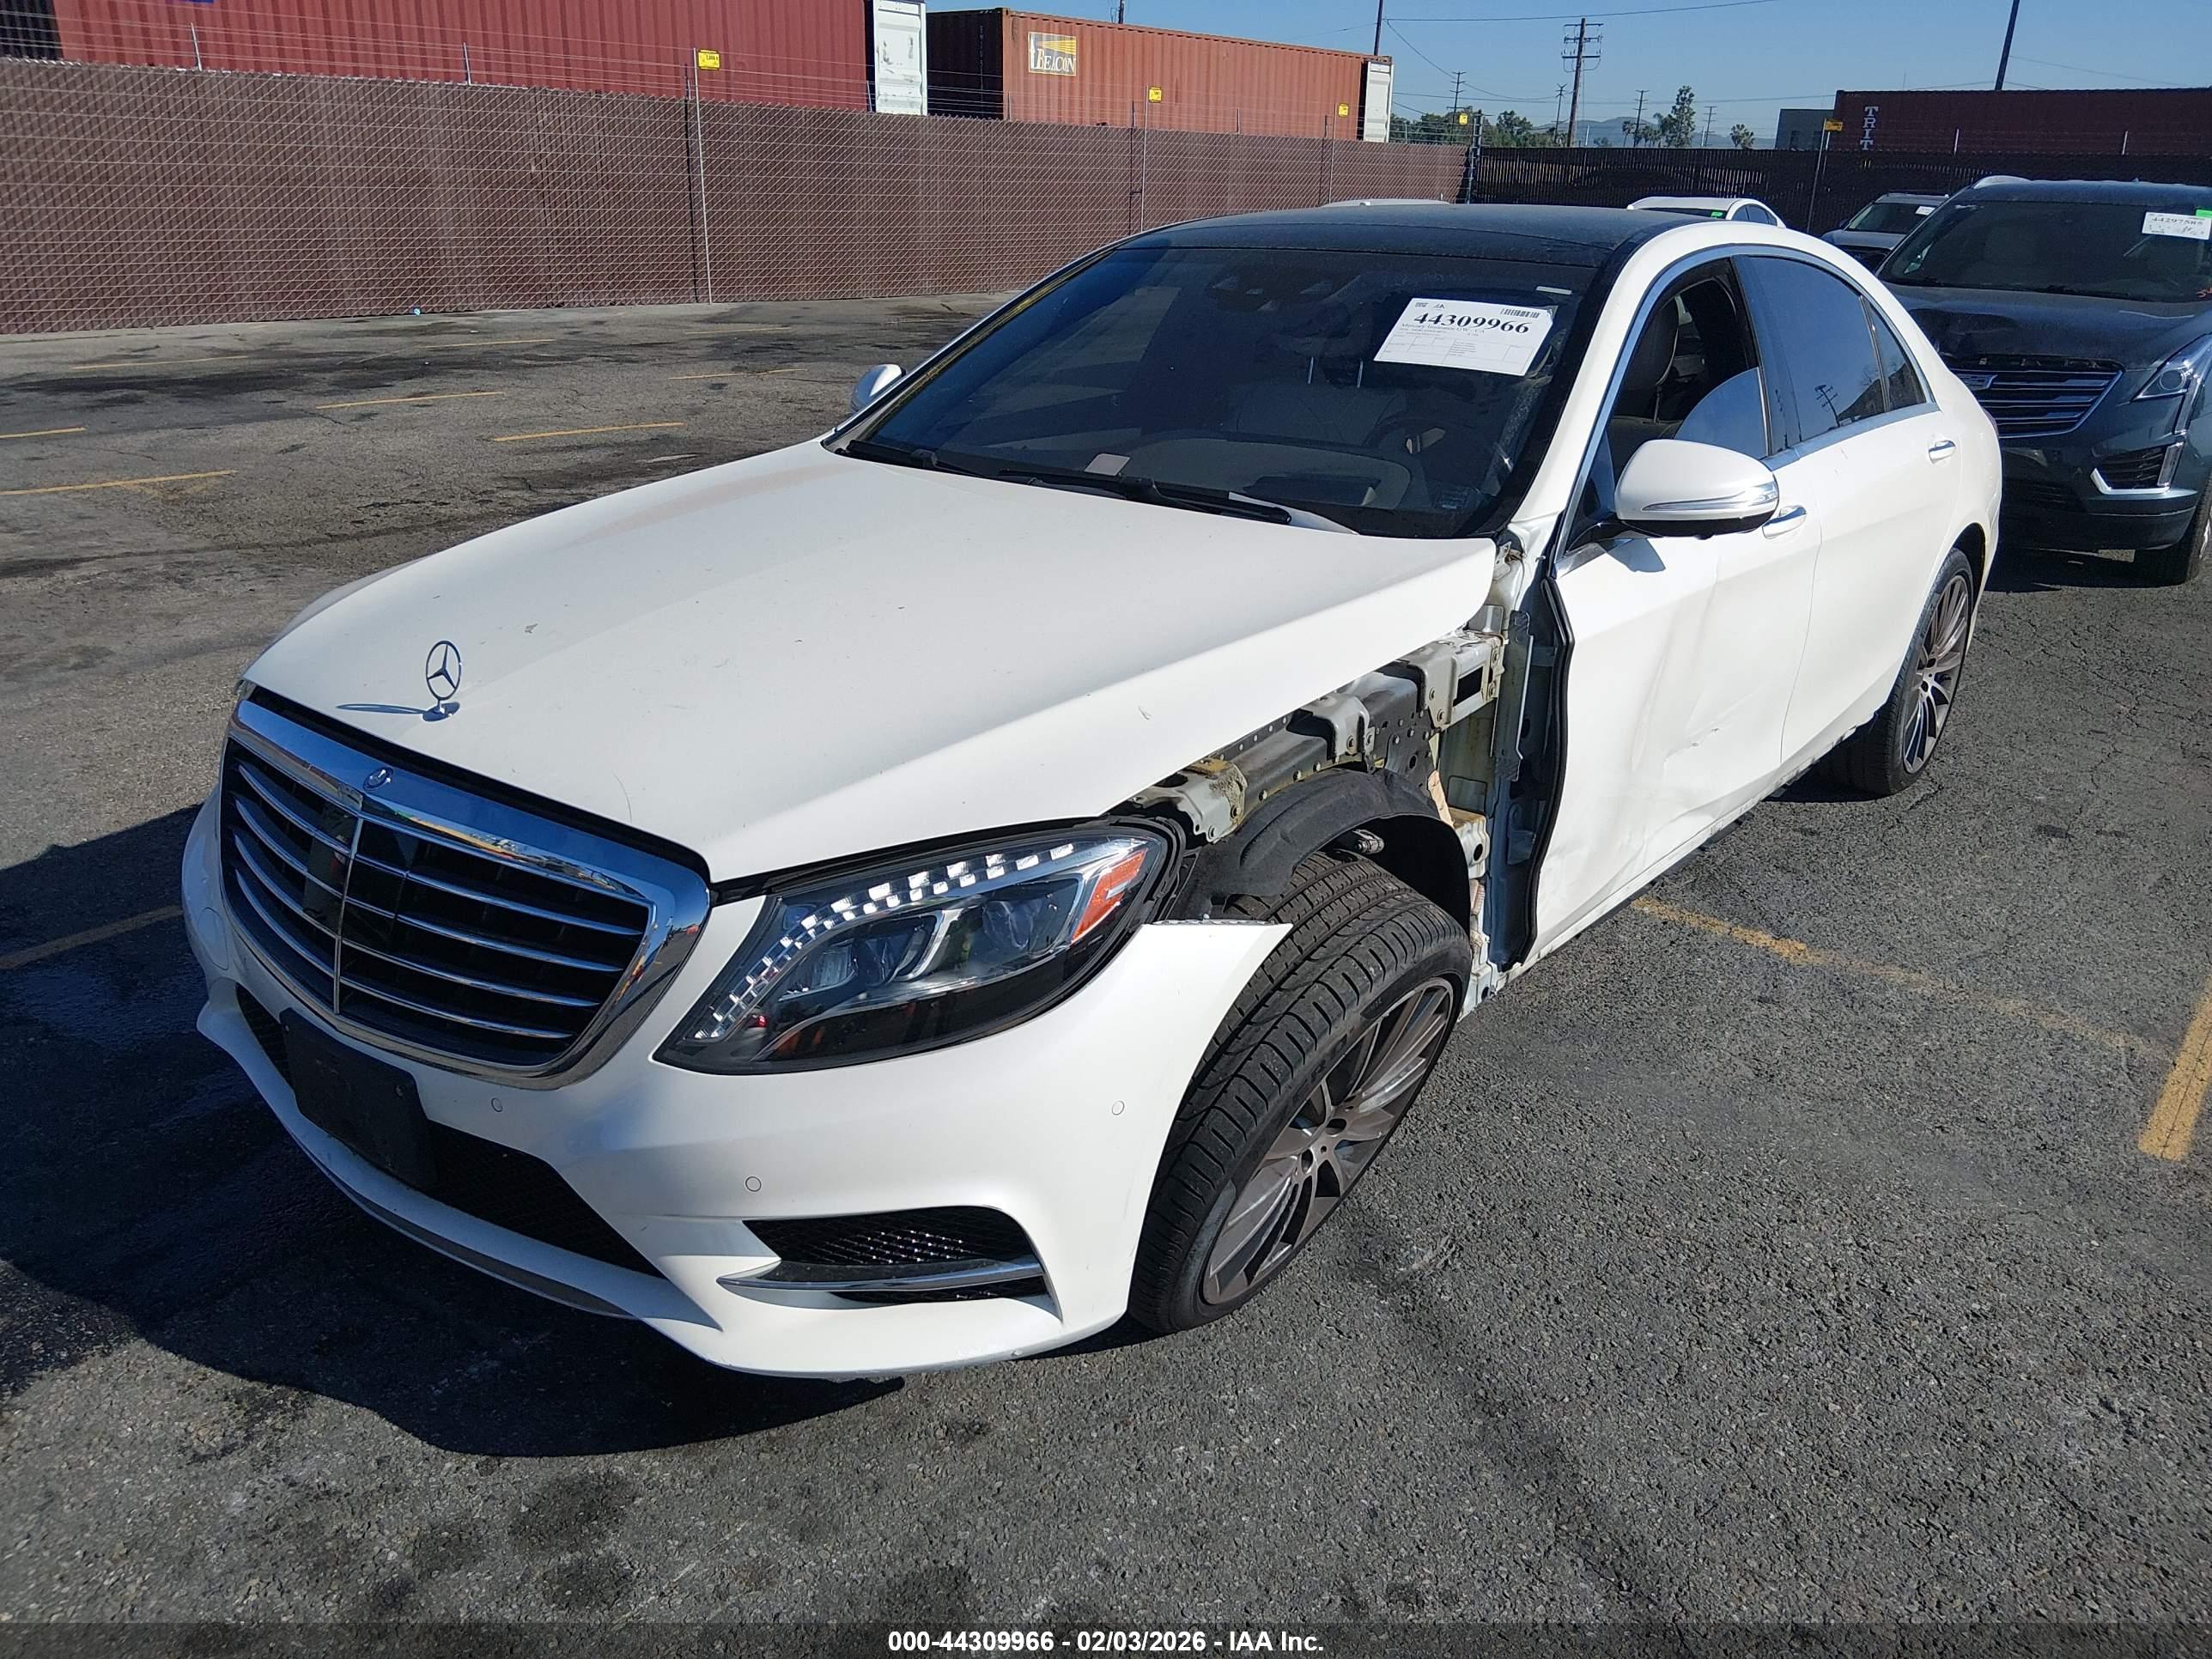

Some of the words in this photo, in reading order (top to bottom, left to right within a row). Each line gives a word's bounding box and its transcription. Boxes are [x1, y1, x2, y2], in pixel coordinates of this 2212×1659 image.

[1036, 48, 1076, 72] BEACON
[1860, 106, 1879, 150] TRIT
[1413, 313, 1532, 334] 44309966
